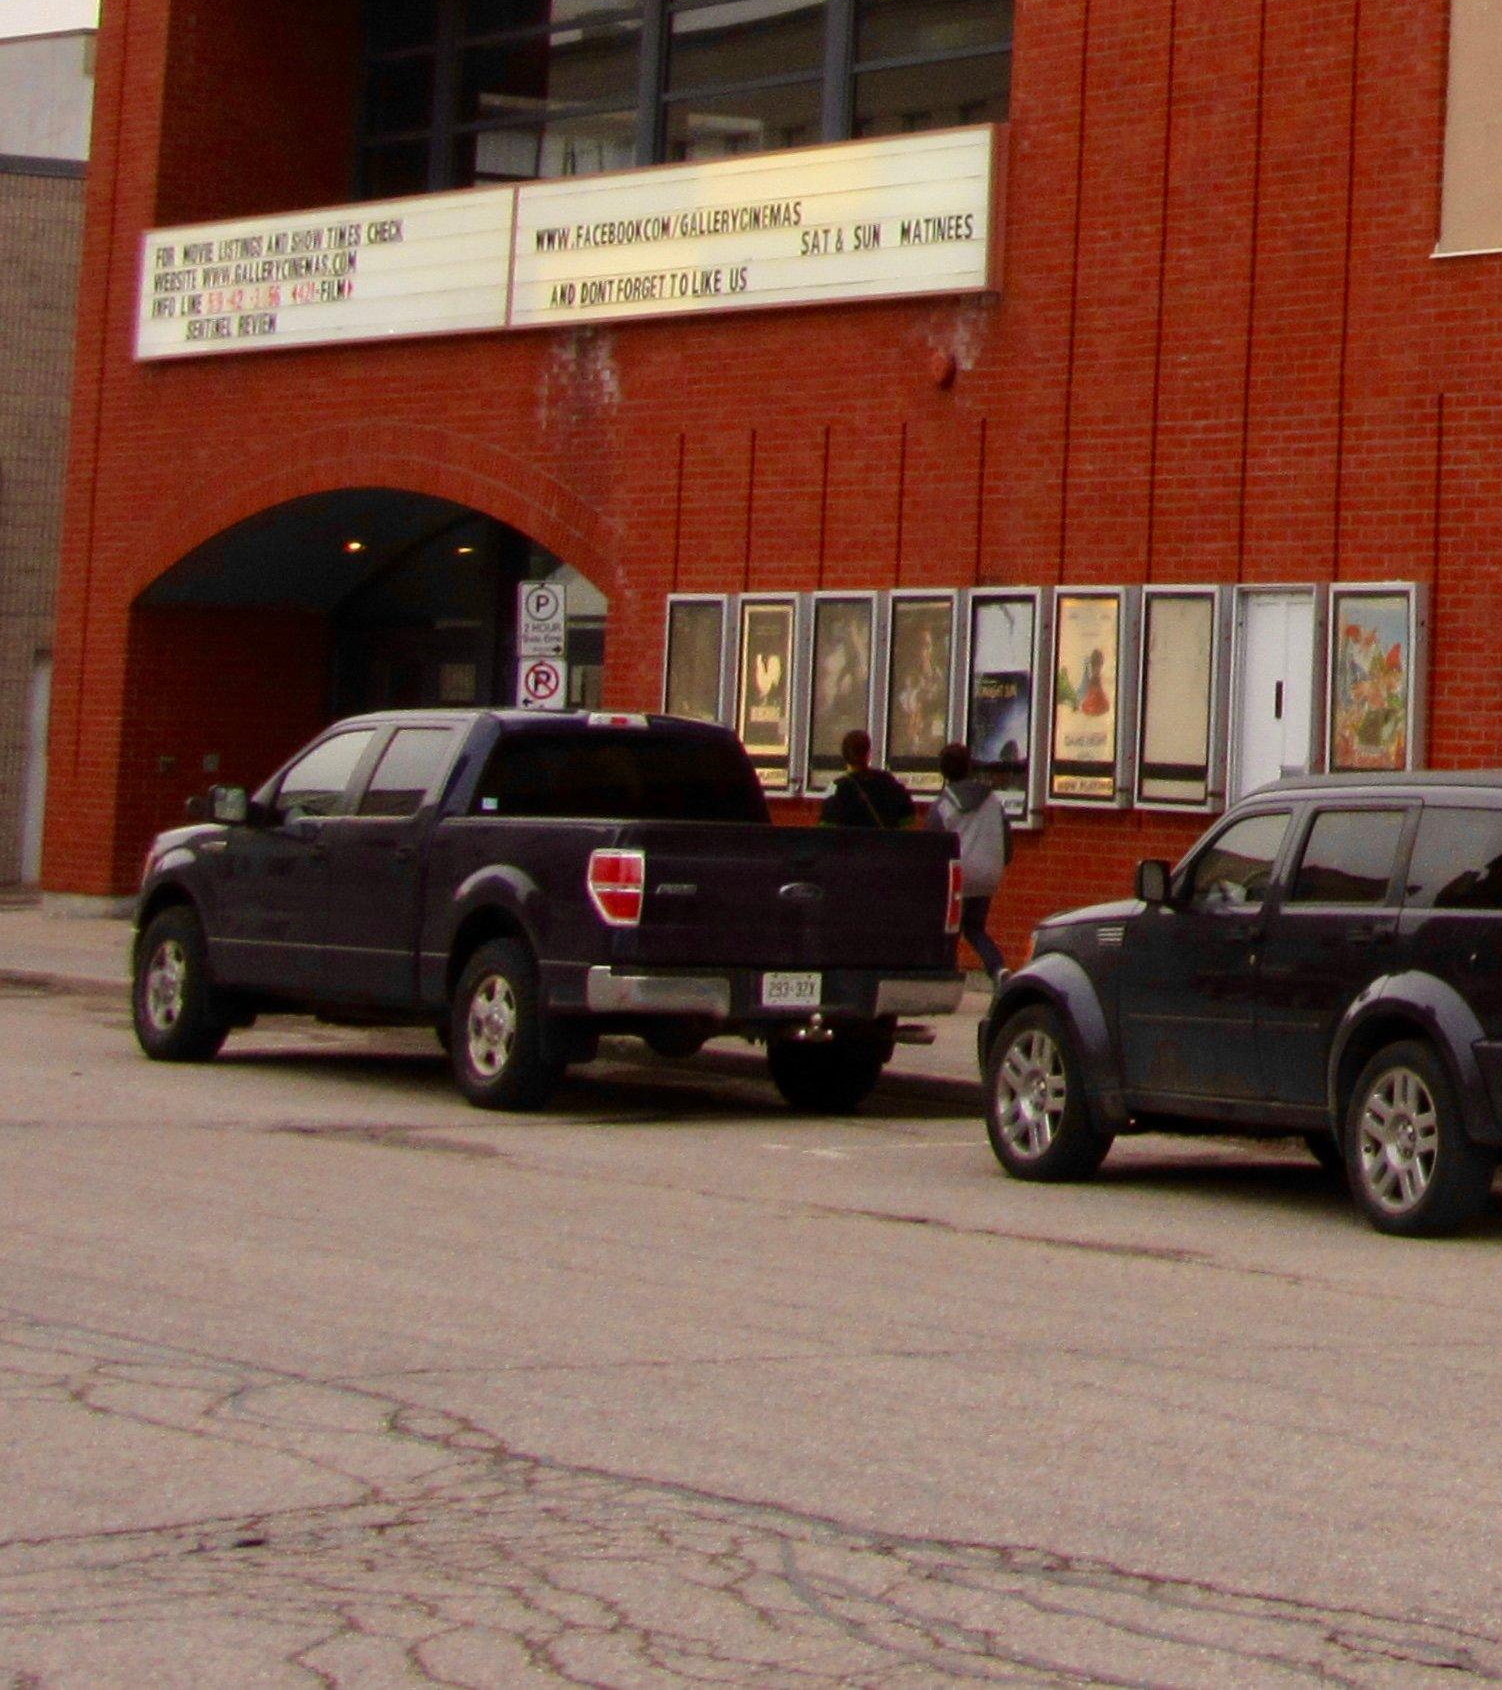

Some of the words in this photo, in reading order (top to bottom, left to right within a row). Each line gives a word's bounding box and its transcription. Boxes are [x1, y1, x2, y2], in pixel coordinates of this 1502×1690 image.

[156, 246, 175, 268] FOR
[182, 242, 214, 264] MOVIE
[218, 235, 263, 260] LISTINGS
[267, 232, 289, 254] AND
[291, 228, 323, 252] SHOW
[326, 223, 362, 249] TIMES
[366, 219, 404, 245] CHECK
[801, 227, 829, 256] SAT
[835, 229, 844, 253] &
[853, 223, 881, 250] SUN
[900, 213, 974, 246] MATINEES
[154, 268, 198, 292] WEBSITE
[202, 250, 357, 289] WWW.GALLERYCINEMAS.COM
[550, 281, 576, 306] AND
[580, 279, 614, 305] DONT
[616, 273, 667, 300] FORGET
[670, 271, 689, 296] TO
[692, 268, 722, 297] LIKE
[729, 266, 748, 291] US
[151, 295, 176, 319] INFO
[180, 292, 202, 316] LINE
[185, 316, 231, 340] SENTINEL
[238, 313, 277, 337] REVIEW
[537, 595, 549, 612] P
